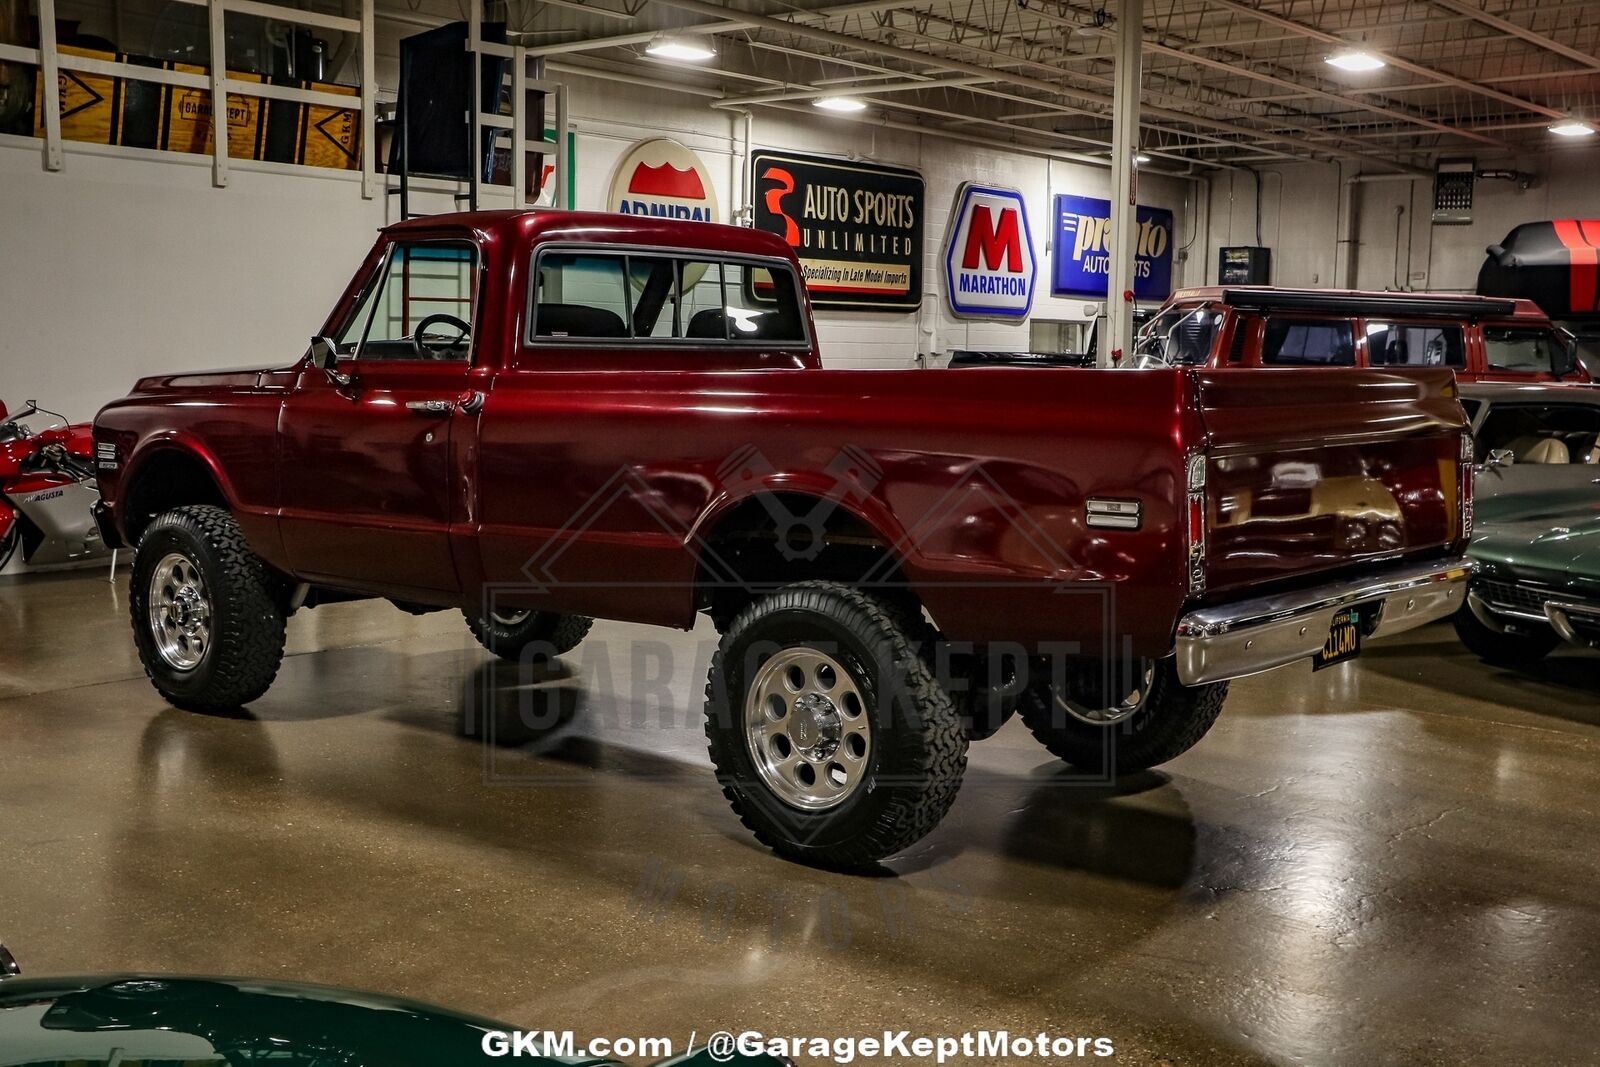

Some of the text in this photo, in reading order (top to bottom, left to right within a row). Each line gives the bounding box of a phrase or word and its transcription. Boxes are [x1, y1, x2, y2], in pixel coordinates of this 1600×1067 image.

[185, 102, 246, 120] GARA EPT
[341, 112, 352, 144] GKM
[804, 184, 914, 229] AUTO SPORTS
[803, 228, 912, 256] UNLIMITED
[962, 204, 1023, 273] M
[1072, 214, 1167, 261] prto
[802, 264, 907, 285] Specializing In Late Model Imports
[960, 273, 1025, 296] MARATHON
[35, 490, 64, 502] AGUSTA
